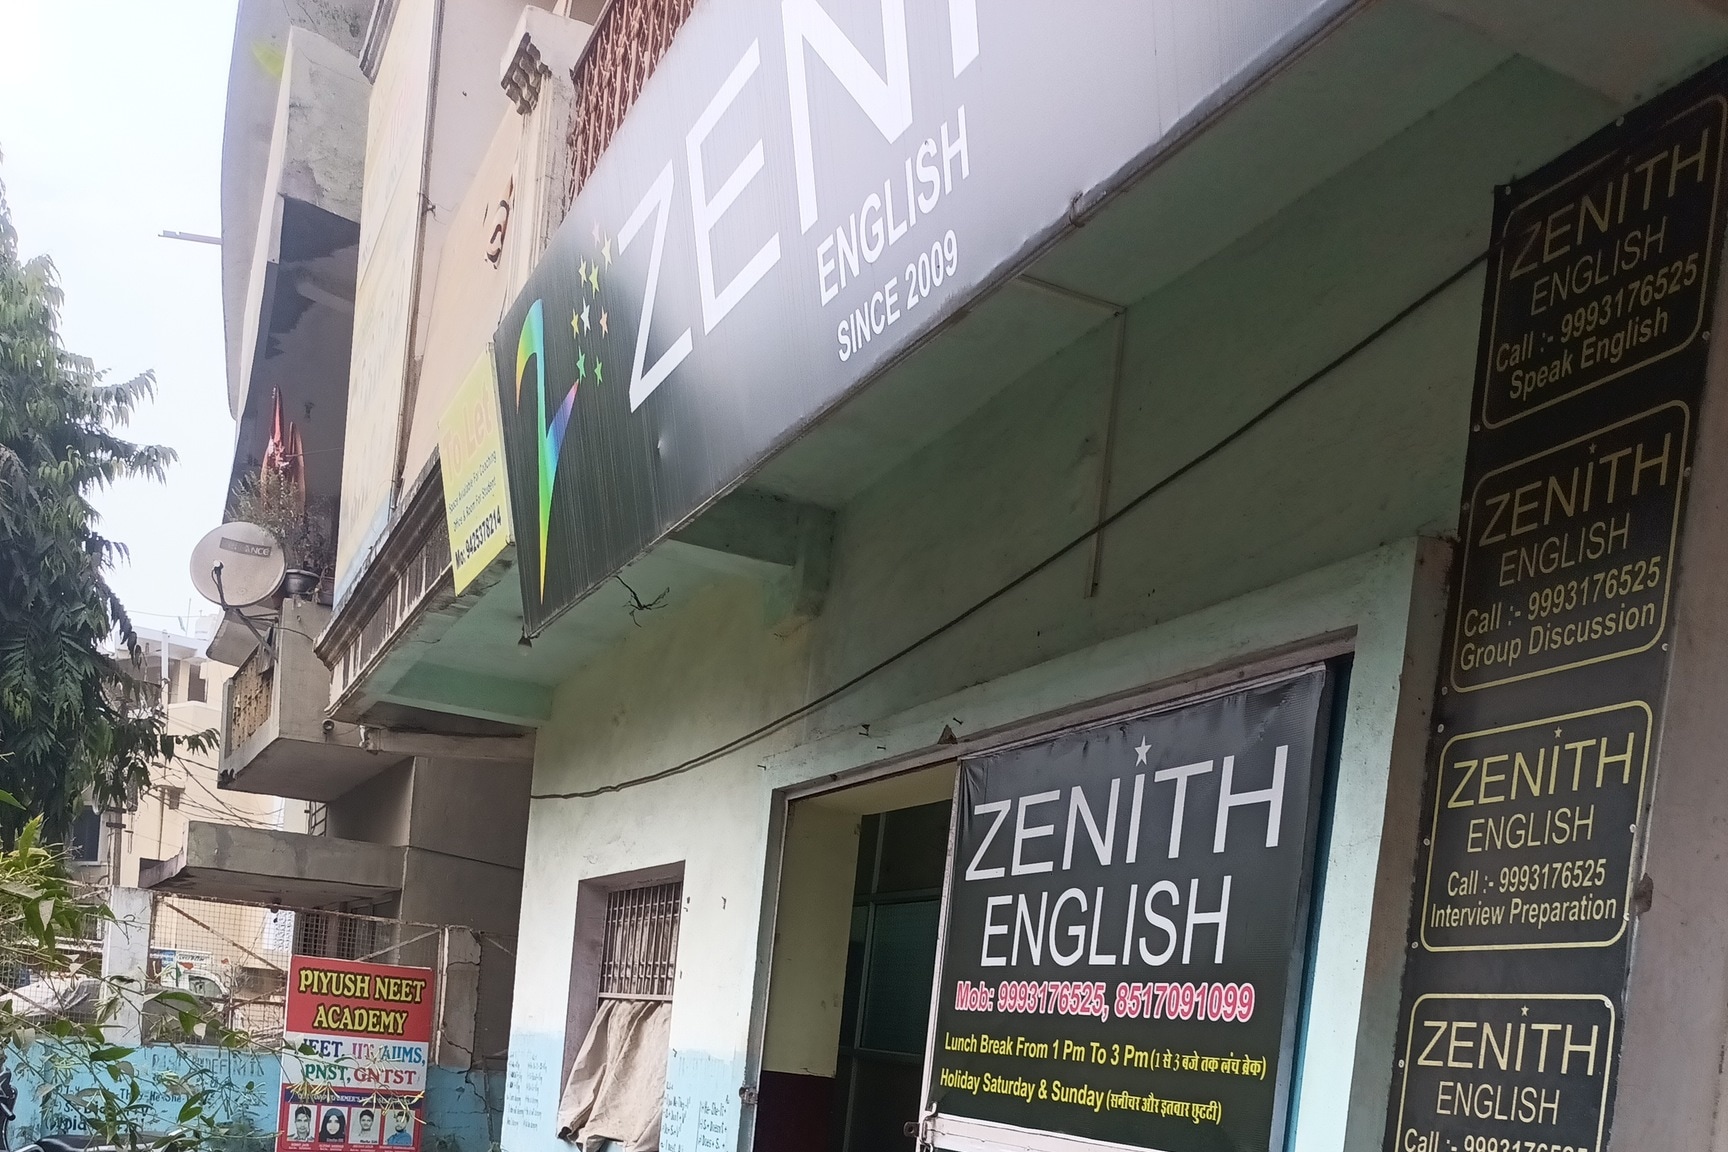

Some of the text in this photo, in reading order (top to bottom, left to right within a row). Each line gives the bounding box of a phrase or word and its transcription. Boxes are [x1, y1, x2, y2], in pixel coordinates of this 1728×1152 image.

[816, 105, 971, 307] ENGLISH
[1510, 127, 1709, 280] ZENITH
[837, 230, 958, 362] SINCE 2009
[1531, 216, 1667, 315] ENGLISH
[1496, 331, 1533, 372] Call
[1561, 253, 1698, 343] 9993176525
[1510, 307, 1667, 401] Speak English
[1479, 433, 1671, 547] ZENITH
[465, 505, 501, 559] 9425378214
[1499, 513, 1629, 587] ENGLISH
[1464, 601, 1501, 636] Call
[1528, 556, 1661, 621] 9993176525
[1461, 602, 1655, 670] Group Discussion
[1447, 732, 1635, 808] ZENITH
[965, 744, 1288, 882] ZENITH
[1467, 804, 1594, 852] ENGLISH
[1447, 870, 1479, 896] Call
[1499, 859, 1606, 893] 9993176525
[980, 875, 1232, 967] ENGLISH
[1431, 893, 1616, 929] Interview Preparation
[299, 968, 426, 1004] PIYUSH NEET
[955, 981, 1255, 1022] Mob: 9993176525, 8517091099
[297, 1037, 345, 1058] EET,
[313, 1004, 408, 1035] ACADEMY
[1417, 1021, 1598, 1076] ZENITH
[305, 1063, 417, 1085] PNST, GNTST
[945, 1032, 977, 1053] Lunch
[980, 1034, 1013, 1056] Break
[1016, 1036, 1048, 1059] From
[1052, 1039, 1059, 1060] 1
[1063, 1040, 1085, 1062] Pm
[1090, 1041, 1107, 1064] To
[1110, 1043, 1119, 1066] 3
[1162, 1049, 1172, 1069] से
[1182, 1050, 1199, 1071] बजे
[1200, 1056, 1220, 1073] तक
[1220, 1051, 1241, 1075] लंच
[940, 1068, 980, 1095] Holiday
[982, 1073, 1035, 1103] Saturday
[1038, 1079, 1048, 1100] &
[1051, 1080, 1104, 1113] Sunday
[1141, 1092, 1159, 1113] और
[1161, 1099, 1191, 1118] इतवार
[1436, 1081, 1560, 1125] ENGLISH
